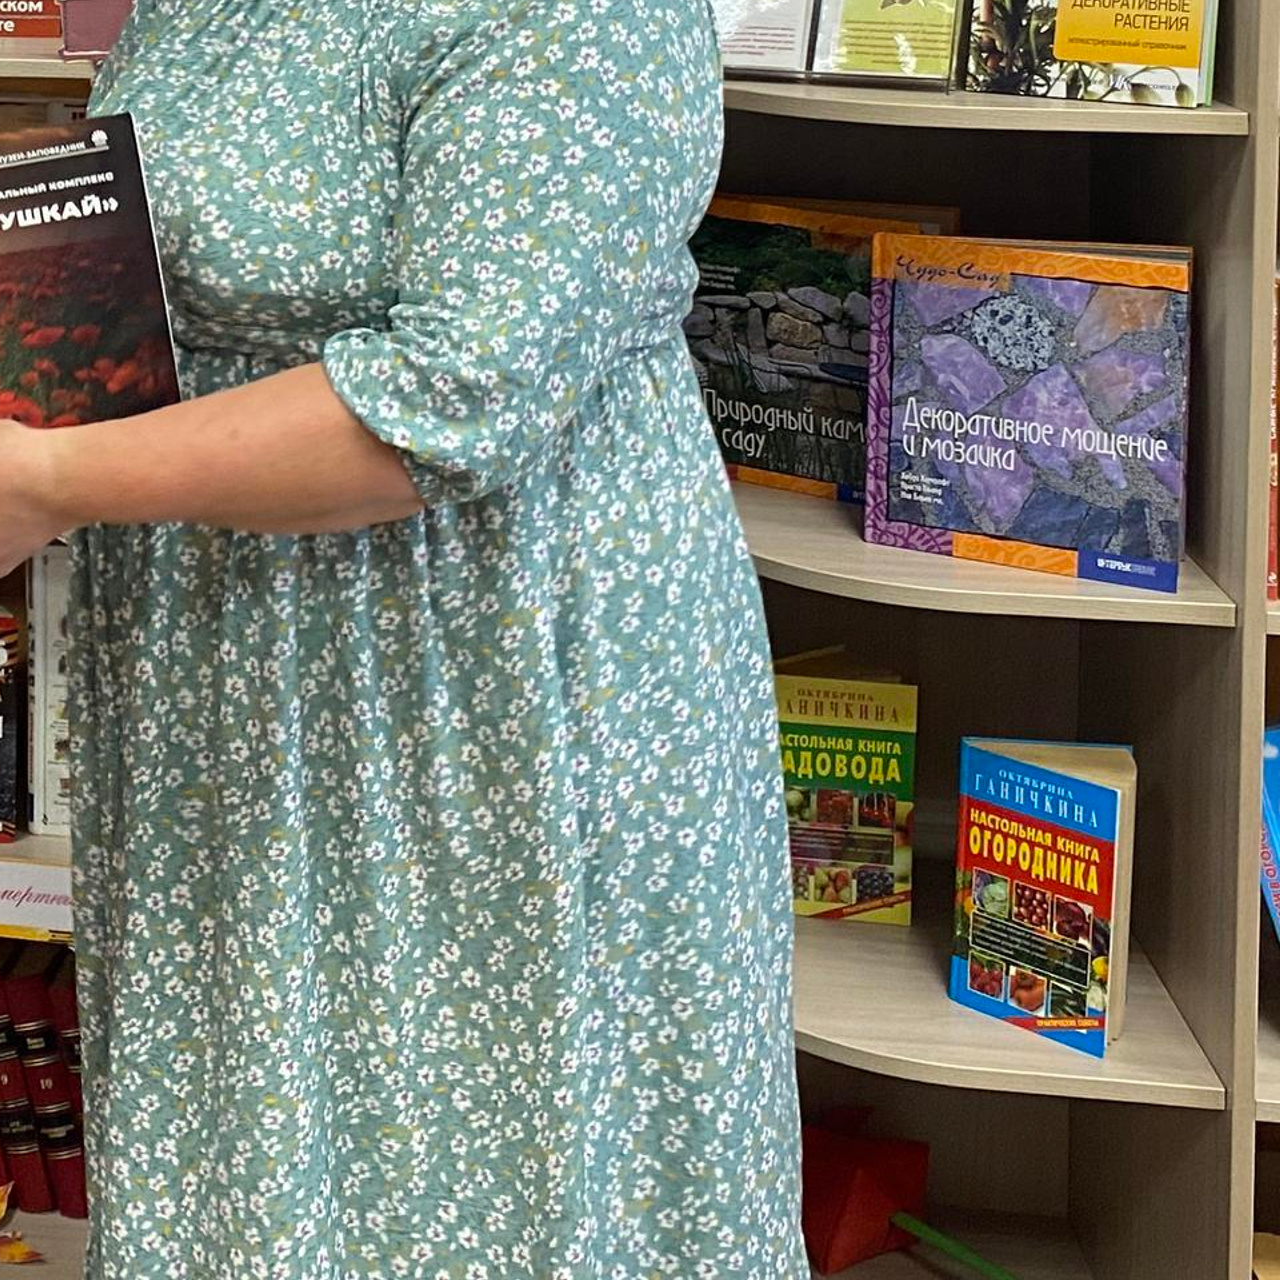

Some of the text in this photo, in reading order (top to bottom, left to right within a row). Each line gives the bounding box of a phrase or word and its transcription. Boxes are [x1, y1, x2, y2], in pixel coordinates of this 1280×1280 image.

[1114, 13, 1190, 32] РАСТЕНИЯ
[48, 171, 115, 192] КОМПЛЕКС
[703, 388, 866, 443] Природный кам
[903, 396, 1168, 462] Декоративное мощение
[722, 427, 766, 458] саду
[903, 436, 1015, 471] и мозаика
[785, 698, 900, 722] АНИЧКИНА
[797, 688, 875, 703] ОКТЯБРИНА
[780, 732, 902, 756] АСТОЛЬНАЯ КНИГА
[782, 751, 902, 785] АДОВОДА
[998, 768, 1074, 801] ОКТЯБРИНА
[974, 773, 1098, 829] ГАНИЧКИНА
[970, 806, 1100, 864] НАСТОЛЬНАЯ КНИГА
[969, 824, 1099, 896] ОГОРОДНИКА
[39, 1078, 53, 1090] 10
